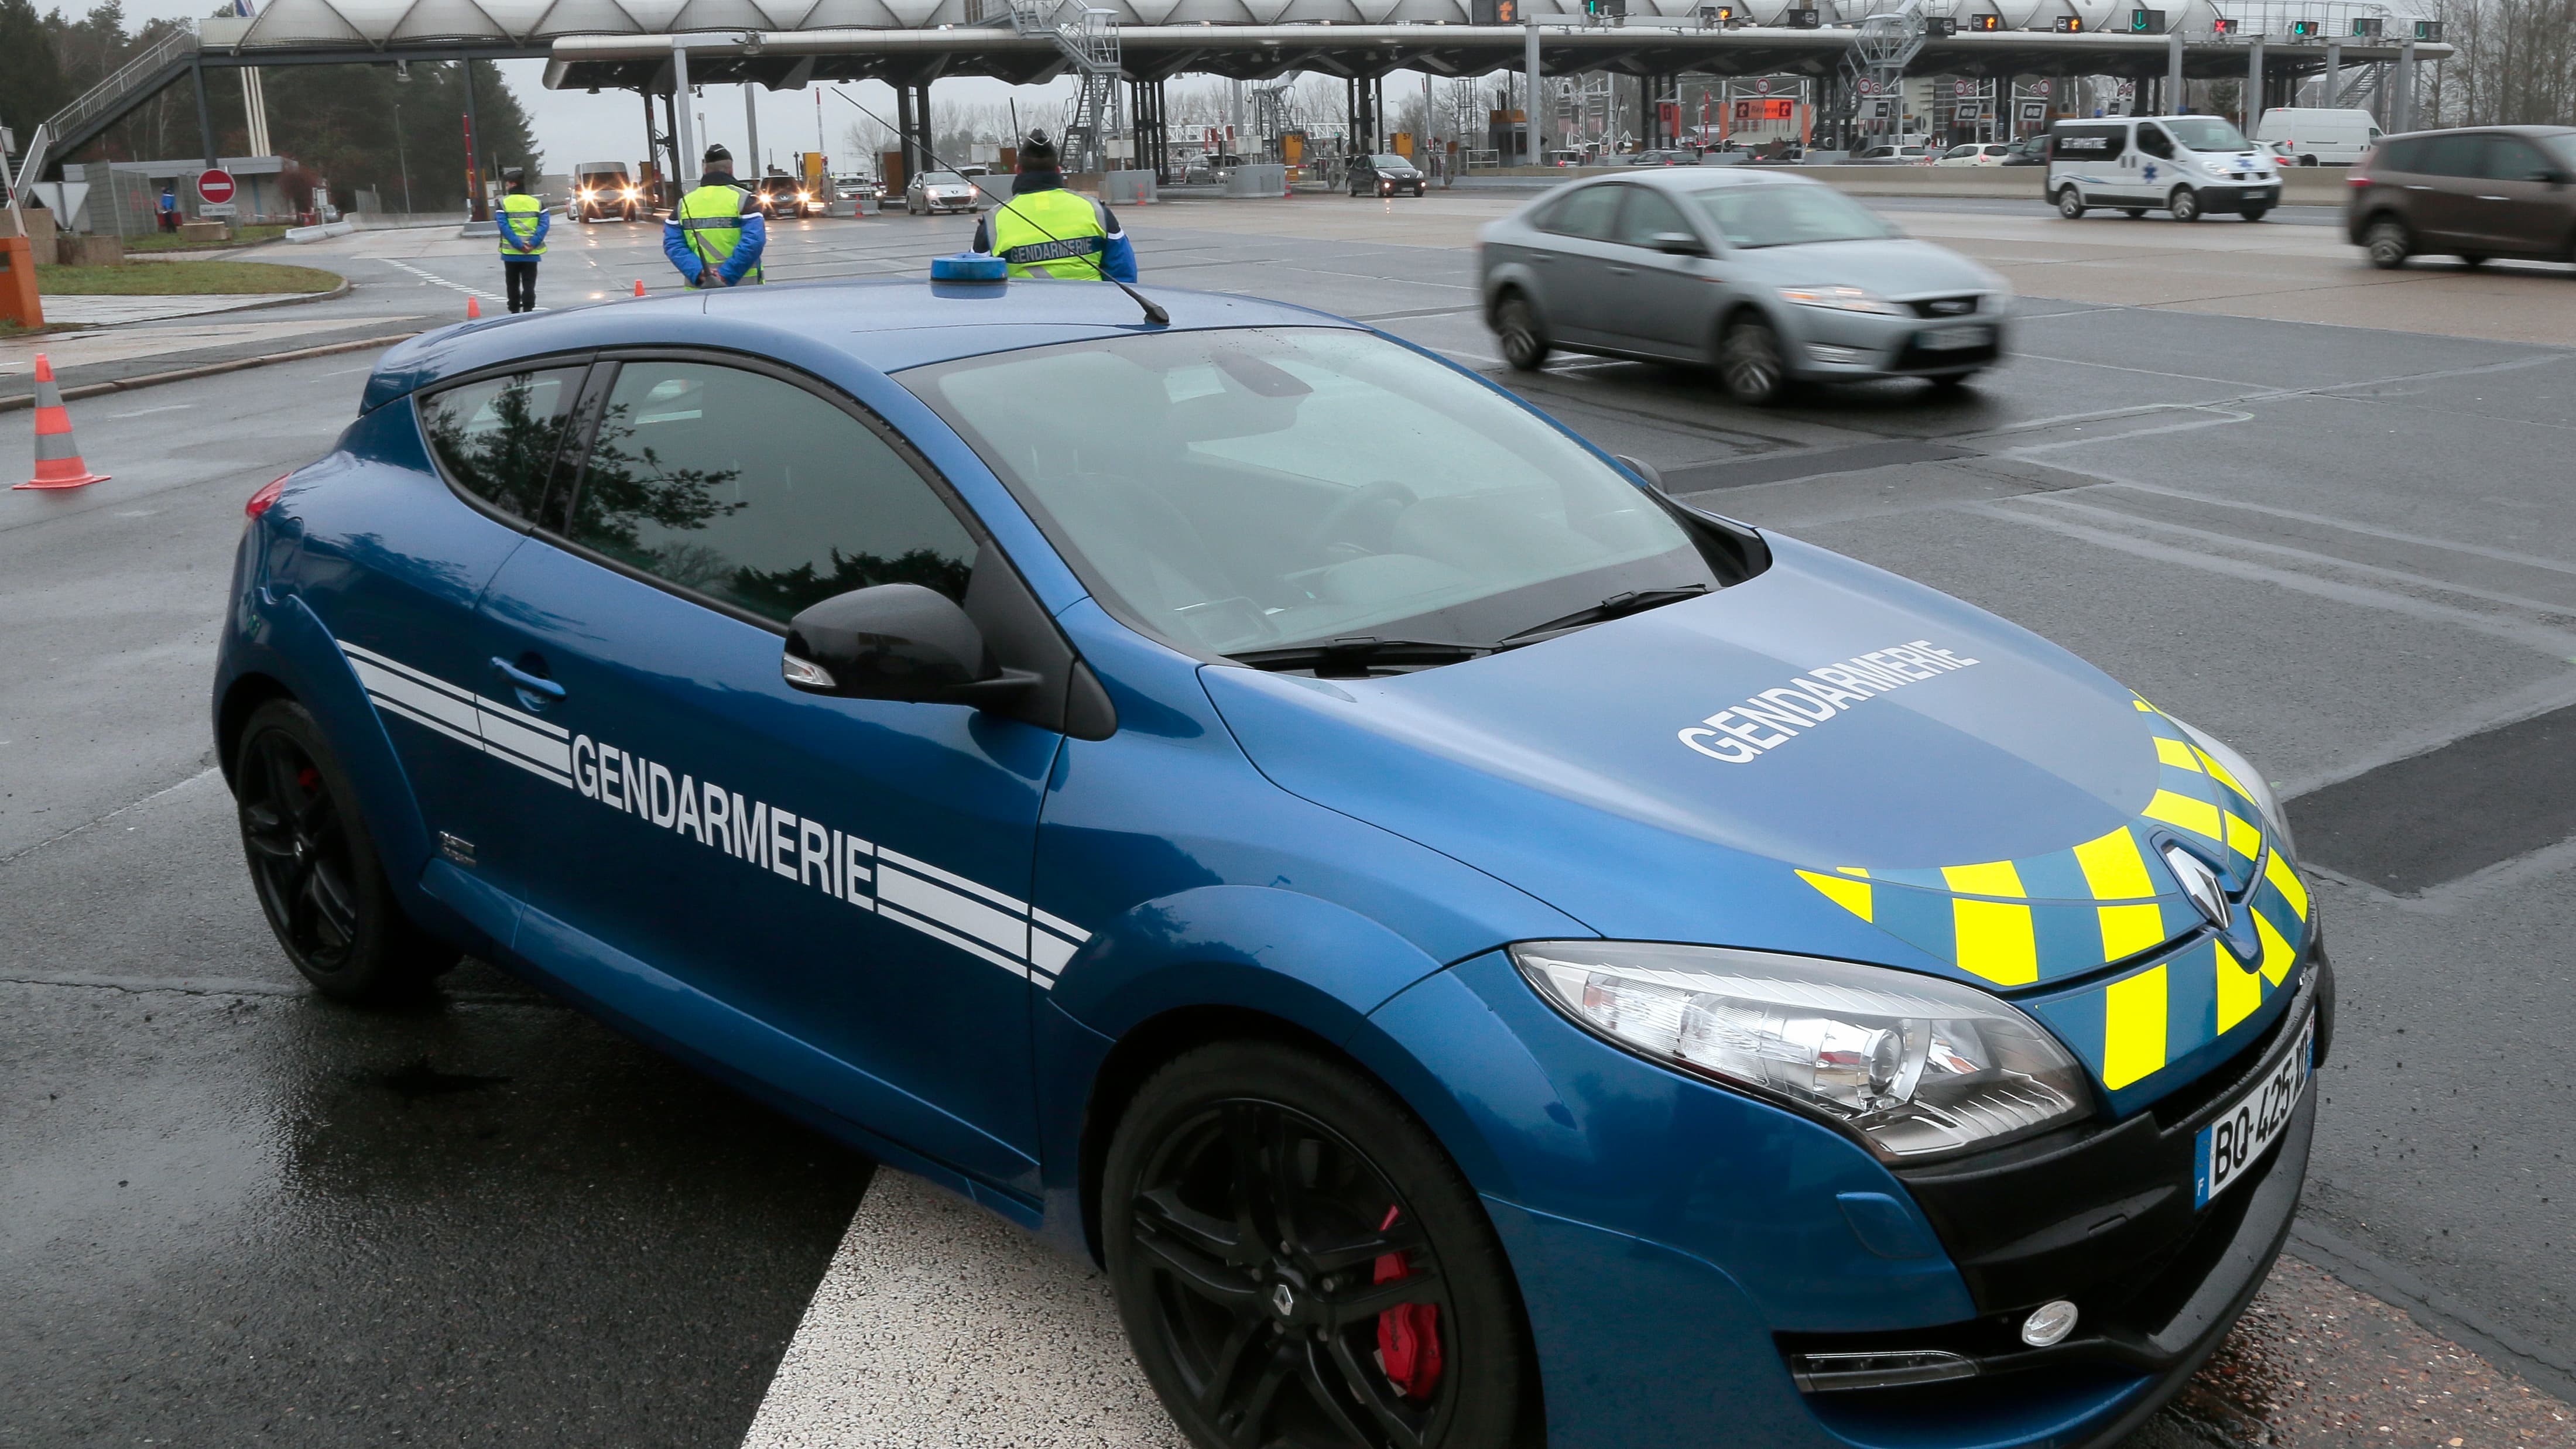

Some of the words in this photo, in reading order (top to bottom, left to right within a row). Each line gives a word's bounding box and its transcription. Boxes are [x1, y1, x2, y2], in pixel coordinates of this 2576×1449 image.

[1010, 238, 1092, 263] GENDARMERIE
[1677, 640, 1981, 763] GENDARMERIE
[572, 734, 877, 912] GENDARMERIE
[2197, 1177, 2204, 1197] F
